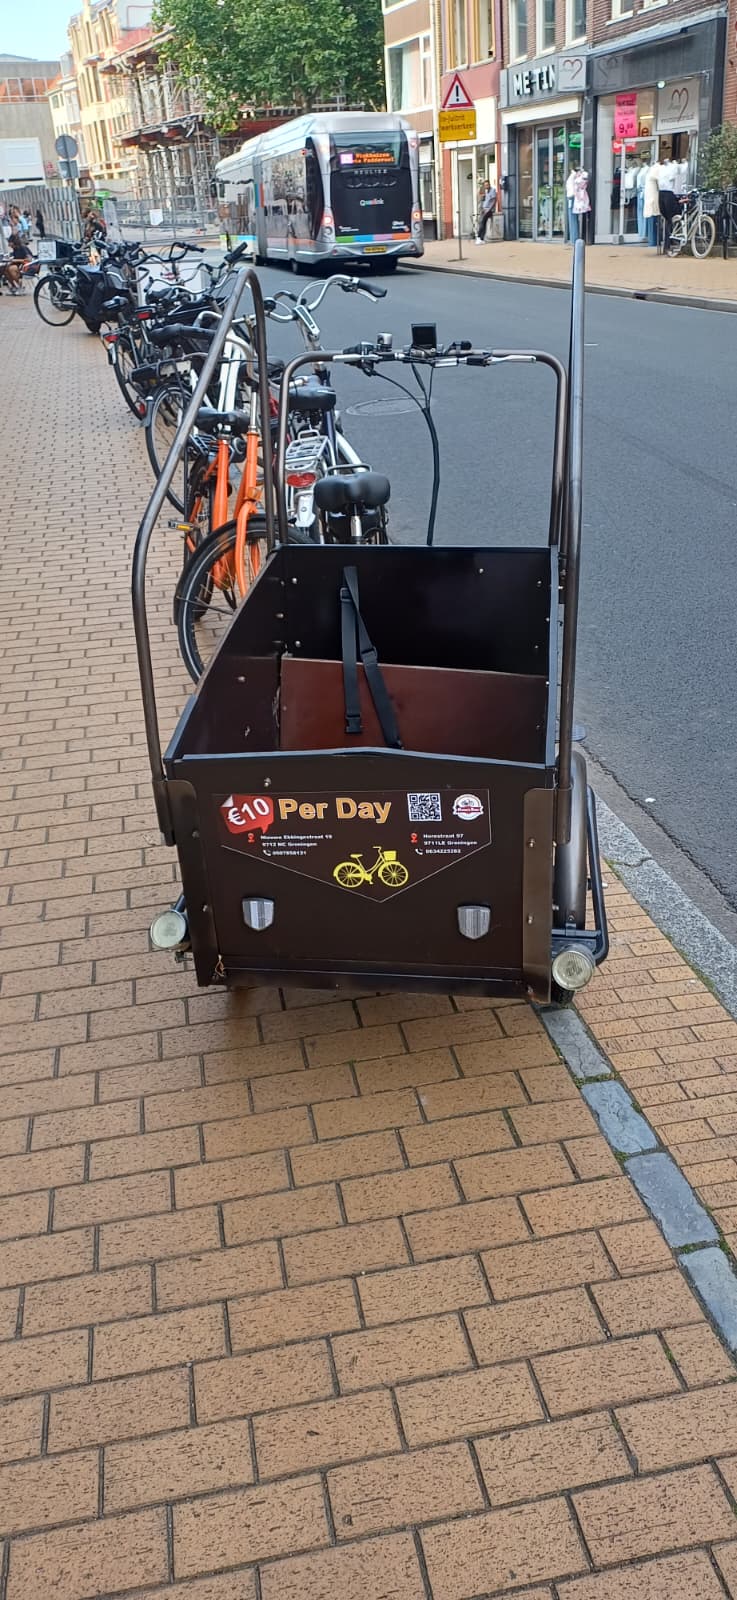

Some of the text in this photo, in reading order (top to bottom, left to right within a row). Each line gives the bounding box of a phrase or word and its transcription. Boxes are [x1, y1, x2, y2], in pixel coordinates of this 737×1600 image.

[227, 797, 392, 826] €10 Per Day
